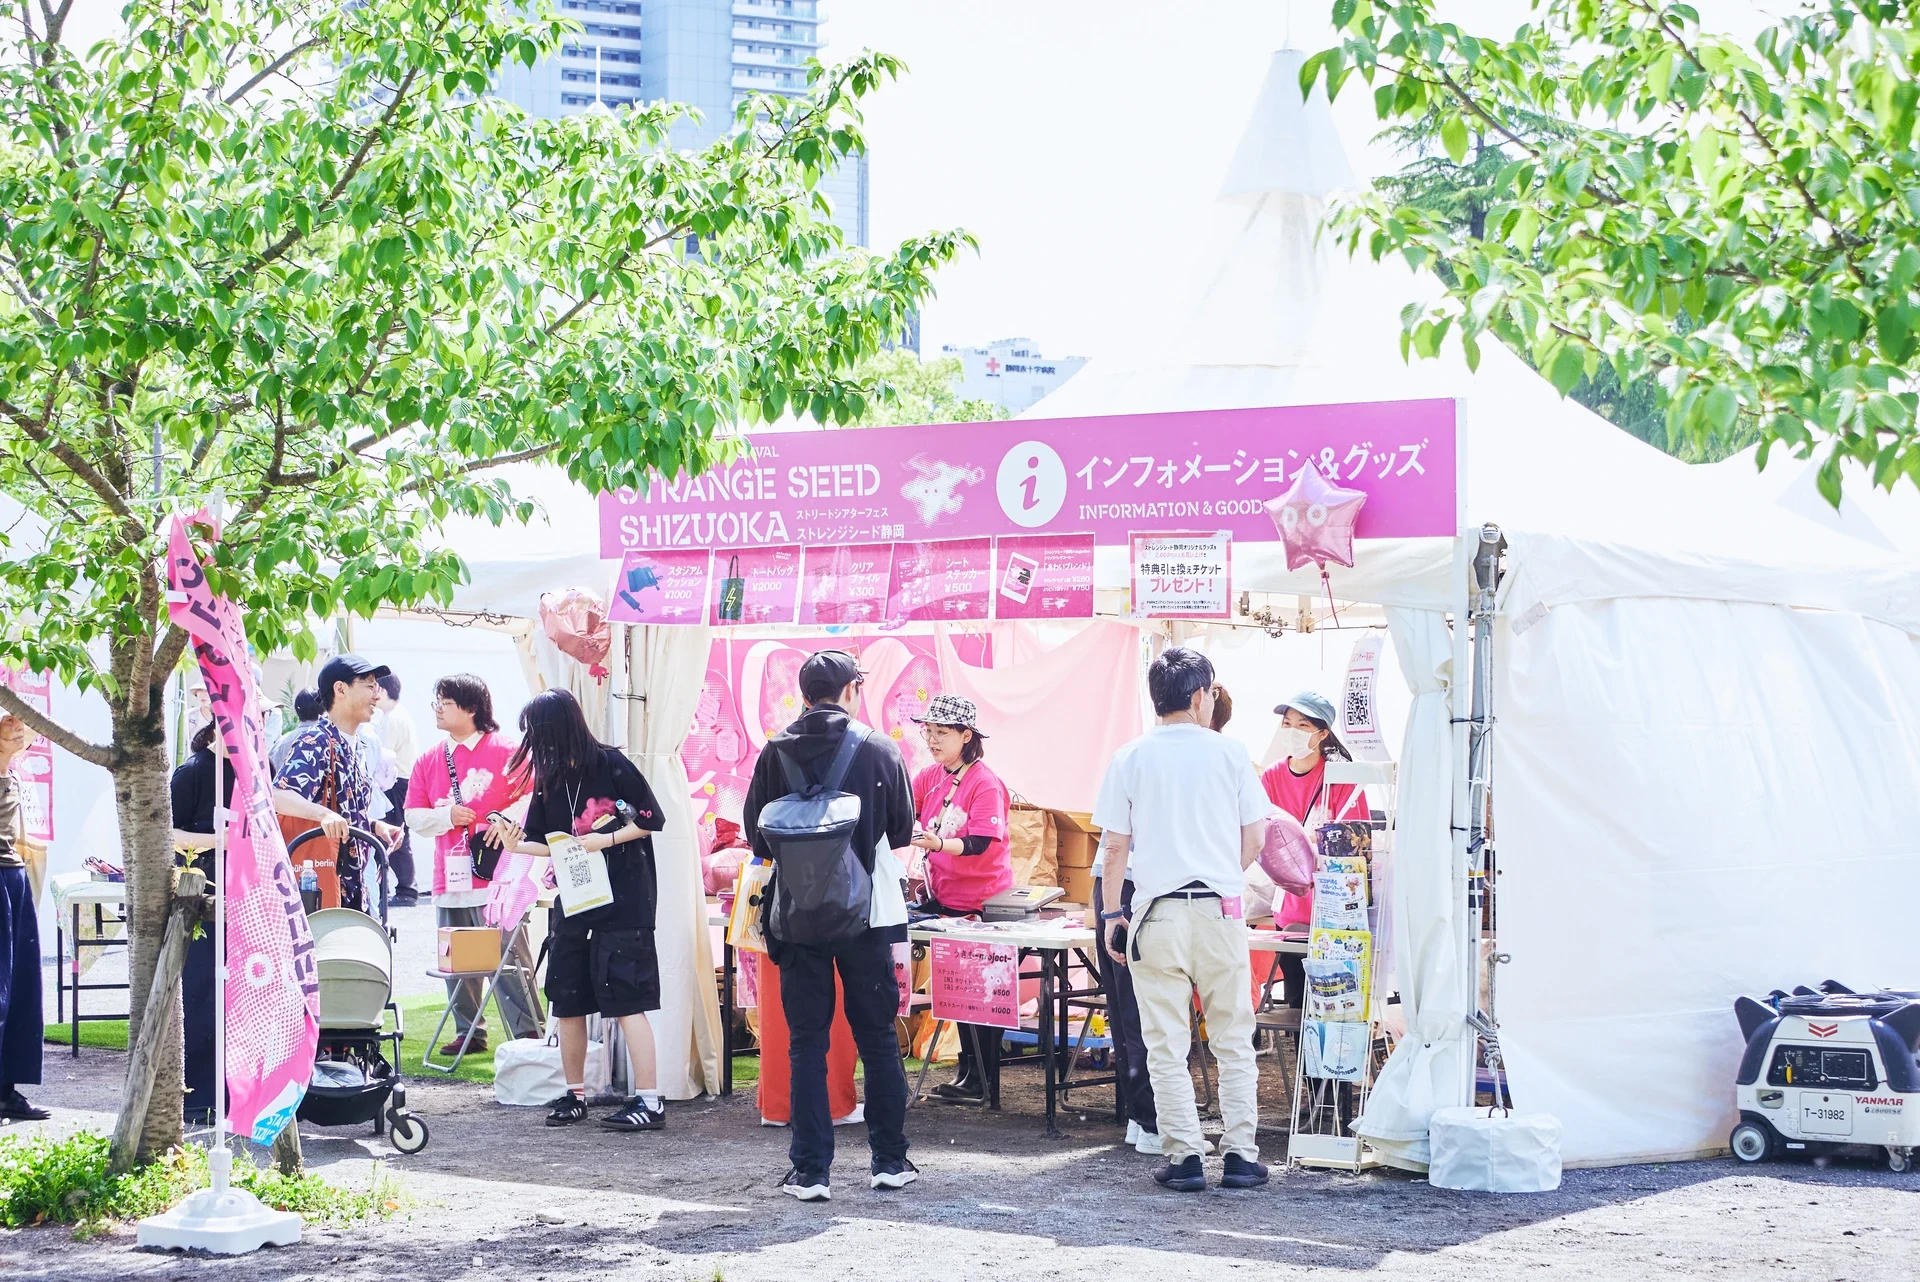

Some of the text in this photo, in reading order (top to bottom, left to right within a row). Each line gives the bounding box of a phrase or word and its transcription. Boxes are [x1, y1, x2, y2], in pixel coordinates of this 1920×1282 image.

[788, 463, 881, 499] SEED
[796, 507, 889, 520] ストリートシアターフェス
[1079, 498, 1267, 520] INFORMATION & GOOD
[619, 510, 790, 546] SHIZUOKA
[796, 524, 905, 541] ストレンジシード静岡
[851, 561, 875, 573] クリア
[945, 557, 970, 569] シート
[667, 565, 704, 577] スタジアム
[752, 565, 795, 578] トートバッグ
[944, 568, 986, 581] ステッカー
[1140, 563, 1222, 576] 特典引き換えチケット
[666, 577, 702, 588] クッション
[849, 573, 881, 584] ファイル
[752, 582, 782, 592] ¥2000
[849, 586, 875, 597] ¥300
[944, 582, 972, 593] ¥500
[664, 590, 693, 600] ¥1000
[314, 858, 335, 868] berlin
[1855, 1096, 1904, 1106] YANMAR
[1804, 1107, 1845, 1121] T-31982
